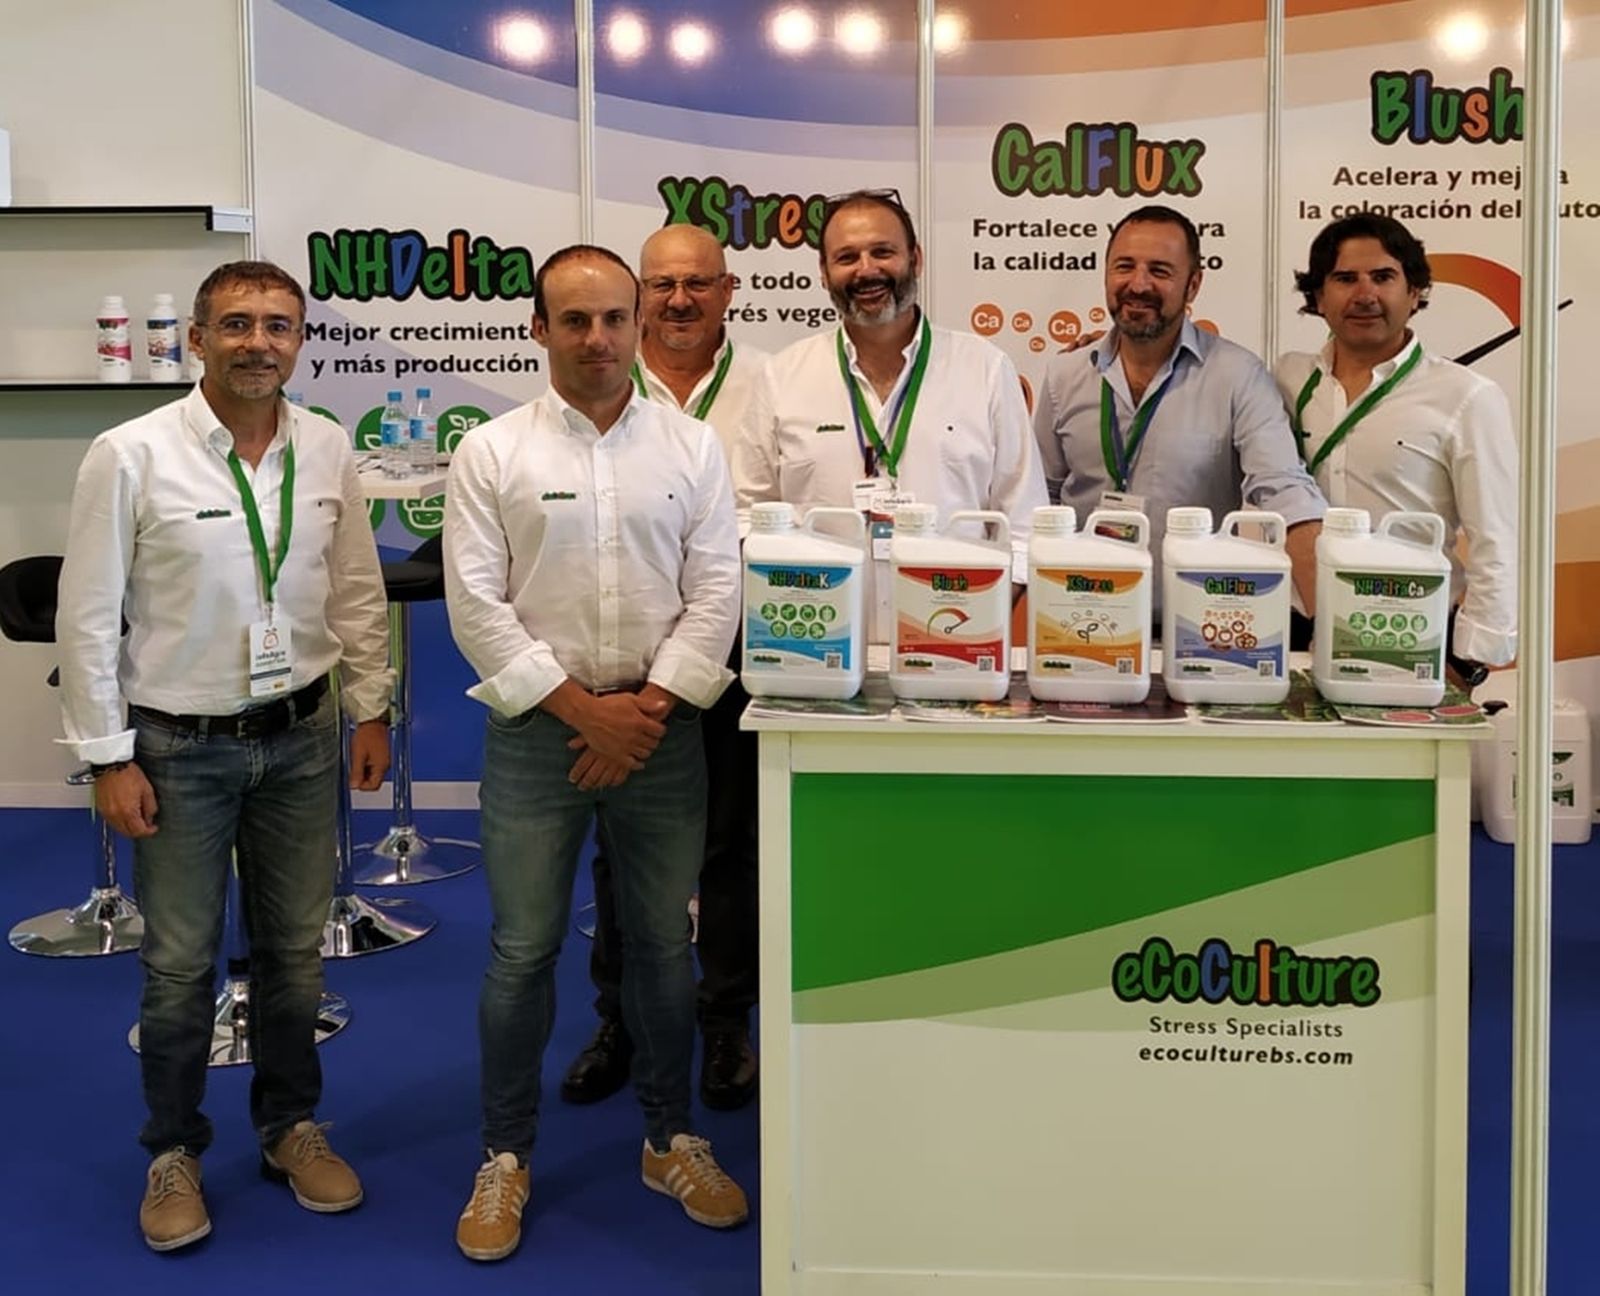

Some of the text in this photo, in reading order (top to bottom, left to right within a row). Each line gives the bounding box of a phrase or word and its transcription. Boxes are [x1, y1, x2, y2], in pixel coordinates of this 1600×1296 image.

[1371, 67, 1524, 145] Blush
[992, 122, 1206, 198] CalFlux
[1332, 166, 1438, 186] Acelera
[1447, 170, 1462, 191] y
[657, 176, 826, 250] XStres
[1300, 200, 1321, 219] la
[1331, 198, 1472, 219] coloración
[1481, 200, 1521, 219] del
[973, 218, 1098, 238] Fortalece
[307, 228, 535, 302] NHDelta
[974, 251, 1096, 270] la calidad
[751, 271, 812, 290] todo
[722, 302, 838, 328] rés vege
[974, 312, 999, 328] Ca
[1015, 316, 1030, 327] Ca
[304, 322, 535, 346] Mejor crecimient
[1050, 319, 1077, 335] Ca
[311, 353, 540, 379] y más producción
[931, 572, 968, 592] Blush
[1204, 576, 1256, 595] CalFlux
[1112, 937, 1381, 1007] eCoCulture
[1150, 1016, 1343, 1039] Stress Specialists
[1139, 1045, 1354, 1065] ecoculturebs.com
